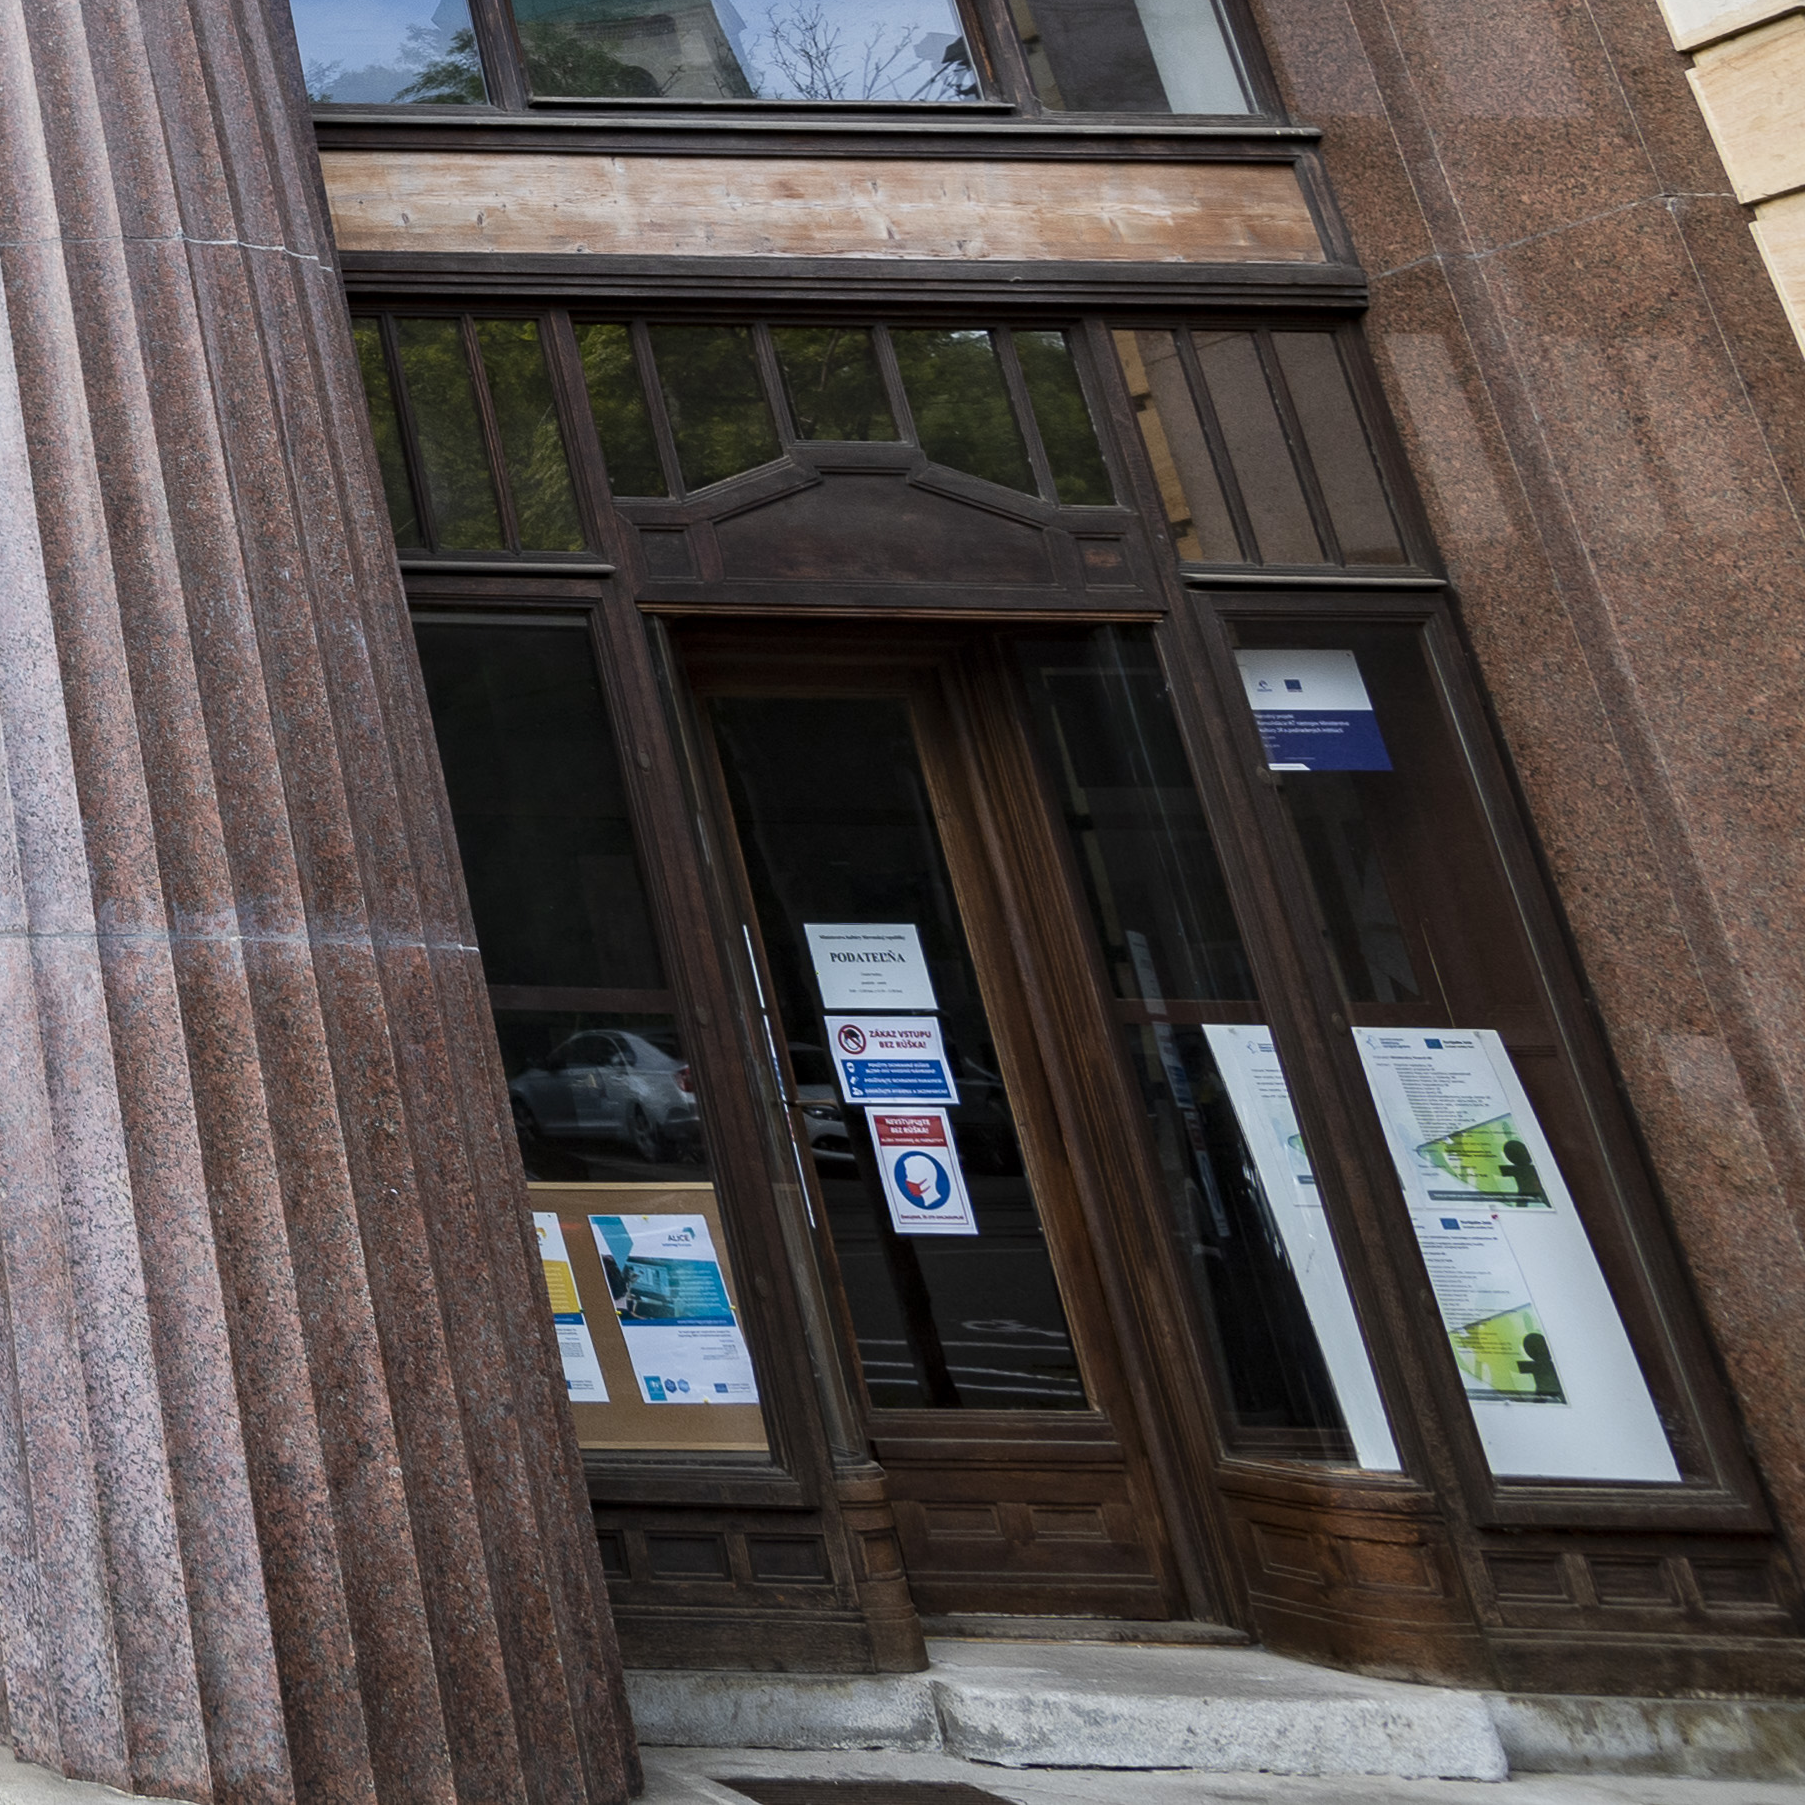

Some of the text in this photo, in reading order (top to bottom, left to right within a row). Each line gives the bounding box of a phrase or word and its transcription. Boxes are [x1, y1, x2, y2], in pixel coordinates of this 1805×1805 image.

[868, 1028, 932, 1038] ZÁKAZ VSTUPU
[878, 1041, 895, 1049] BEZ
[667, 1233, 691, 1242] ALICE
